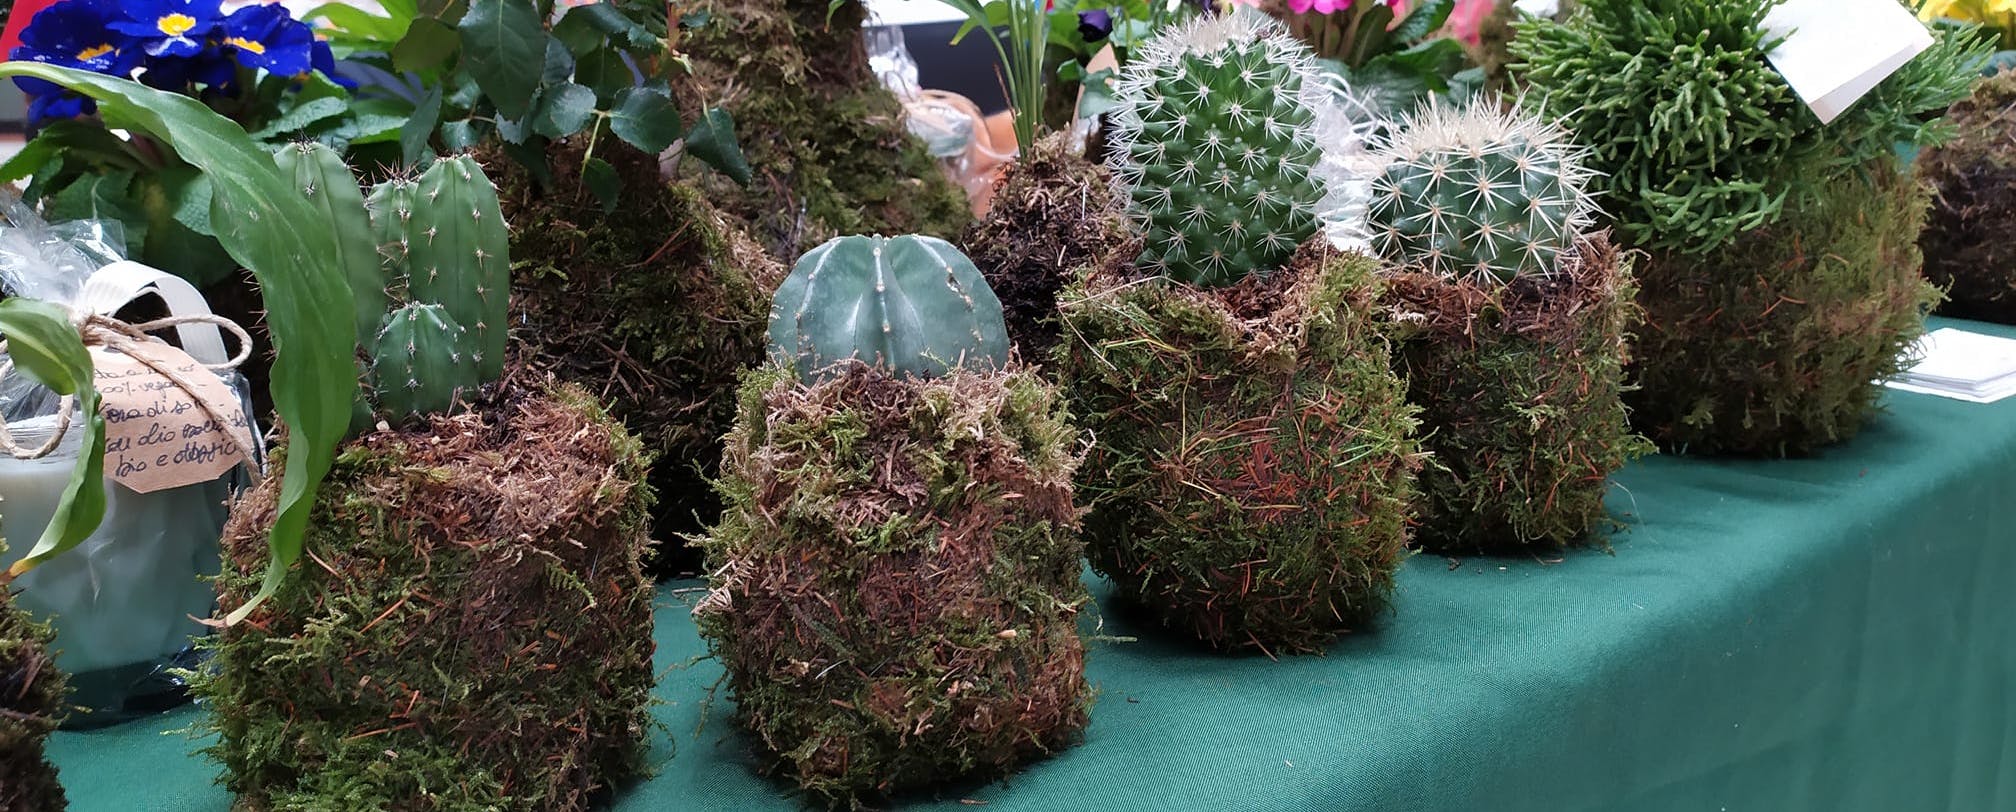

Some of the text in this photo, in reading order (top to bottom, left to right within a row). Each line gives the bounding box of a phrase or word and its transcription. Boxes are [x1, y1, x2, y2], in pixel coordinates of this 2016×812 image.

[94, 381, 136, 397] 00%
[138, 422, 176, 445] olio
[115, 454, 148, 478] bio
